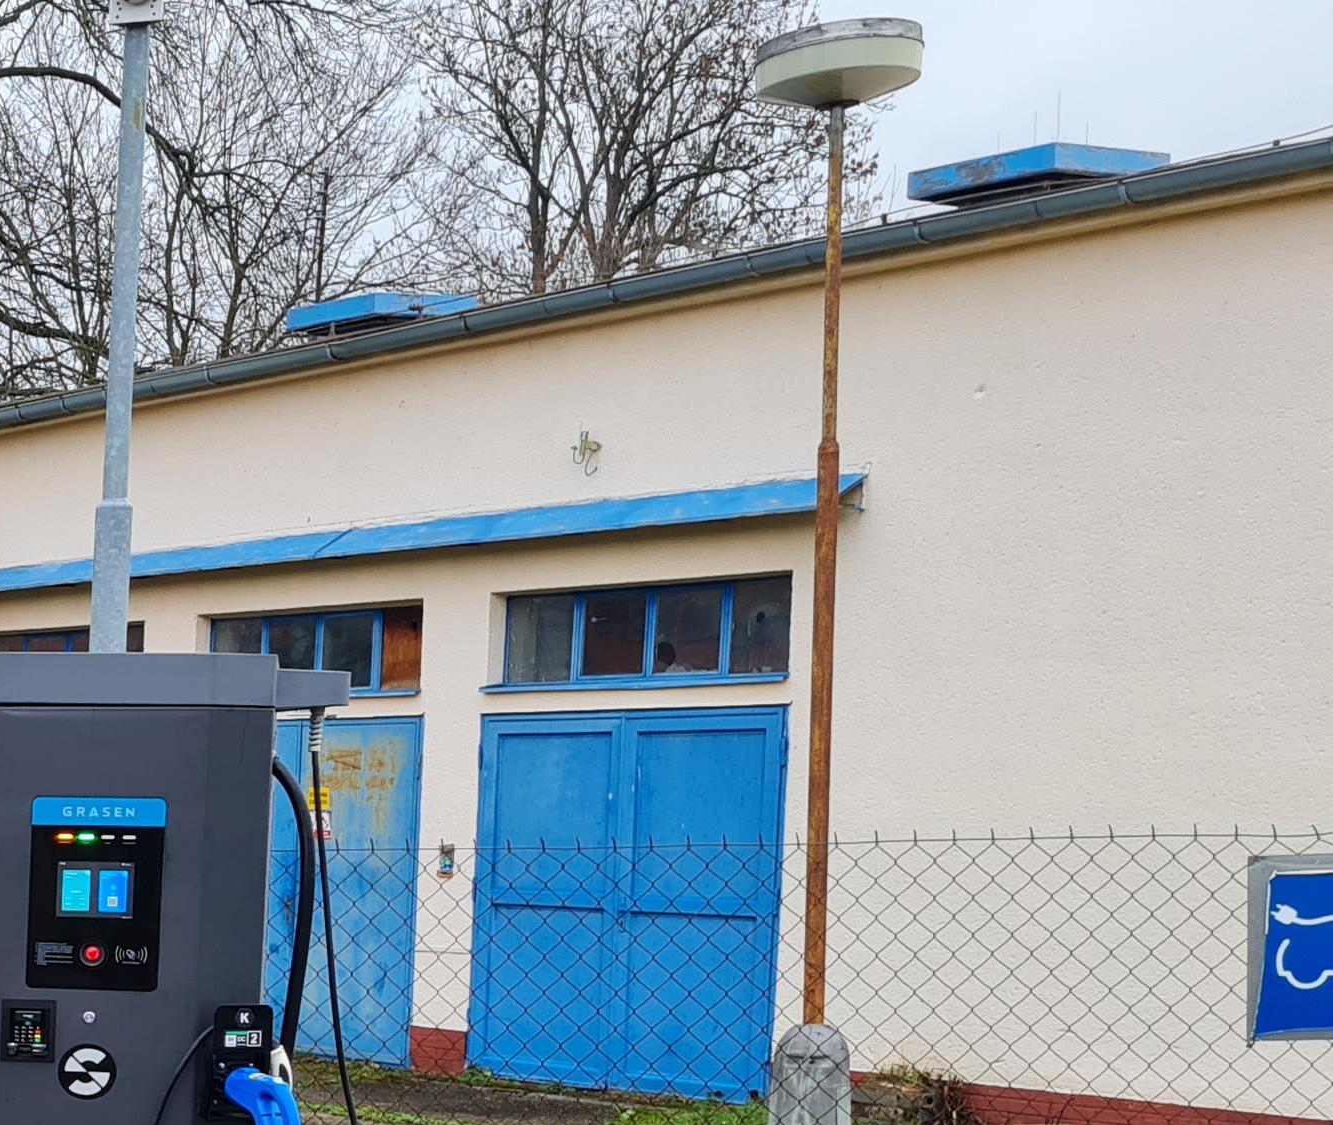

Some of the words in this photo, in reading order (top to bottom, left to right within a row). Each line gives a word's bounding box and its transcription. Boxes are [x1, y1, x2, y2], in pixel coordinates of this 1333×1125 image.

[62, 806, 136, 817] GRASEN
[239, 1012, 250, 1024] K
[250, 1033, 259, 1044] 2
